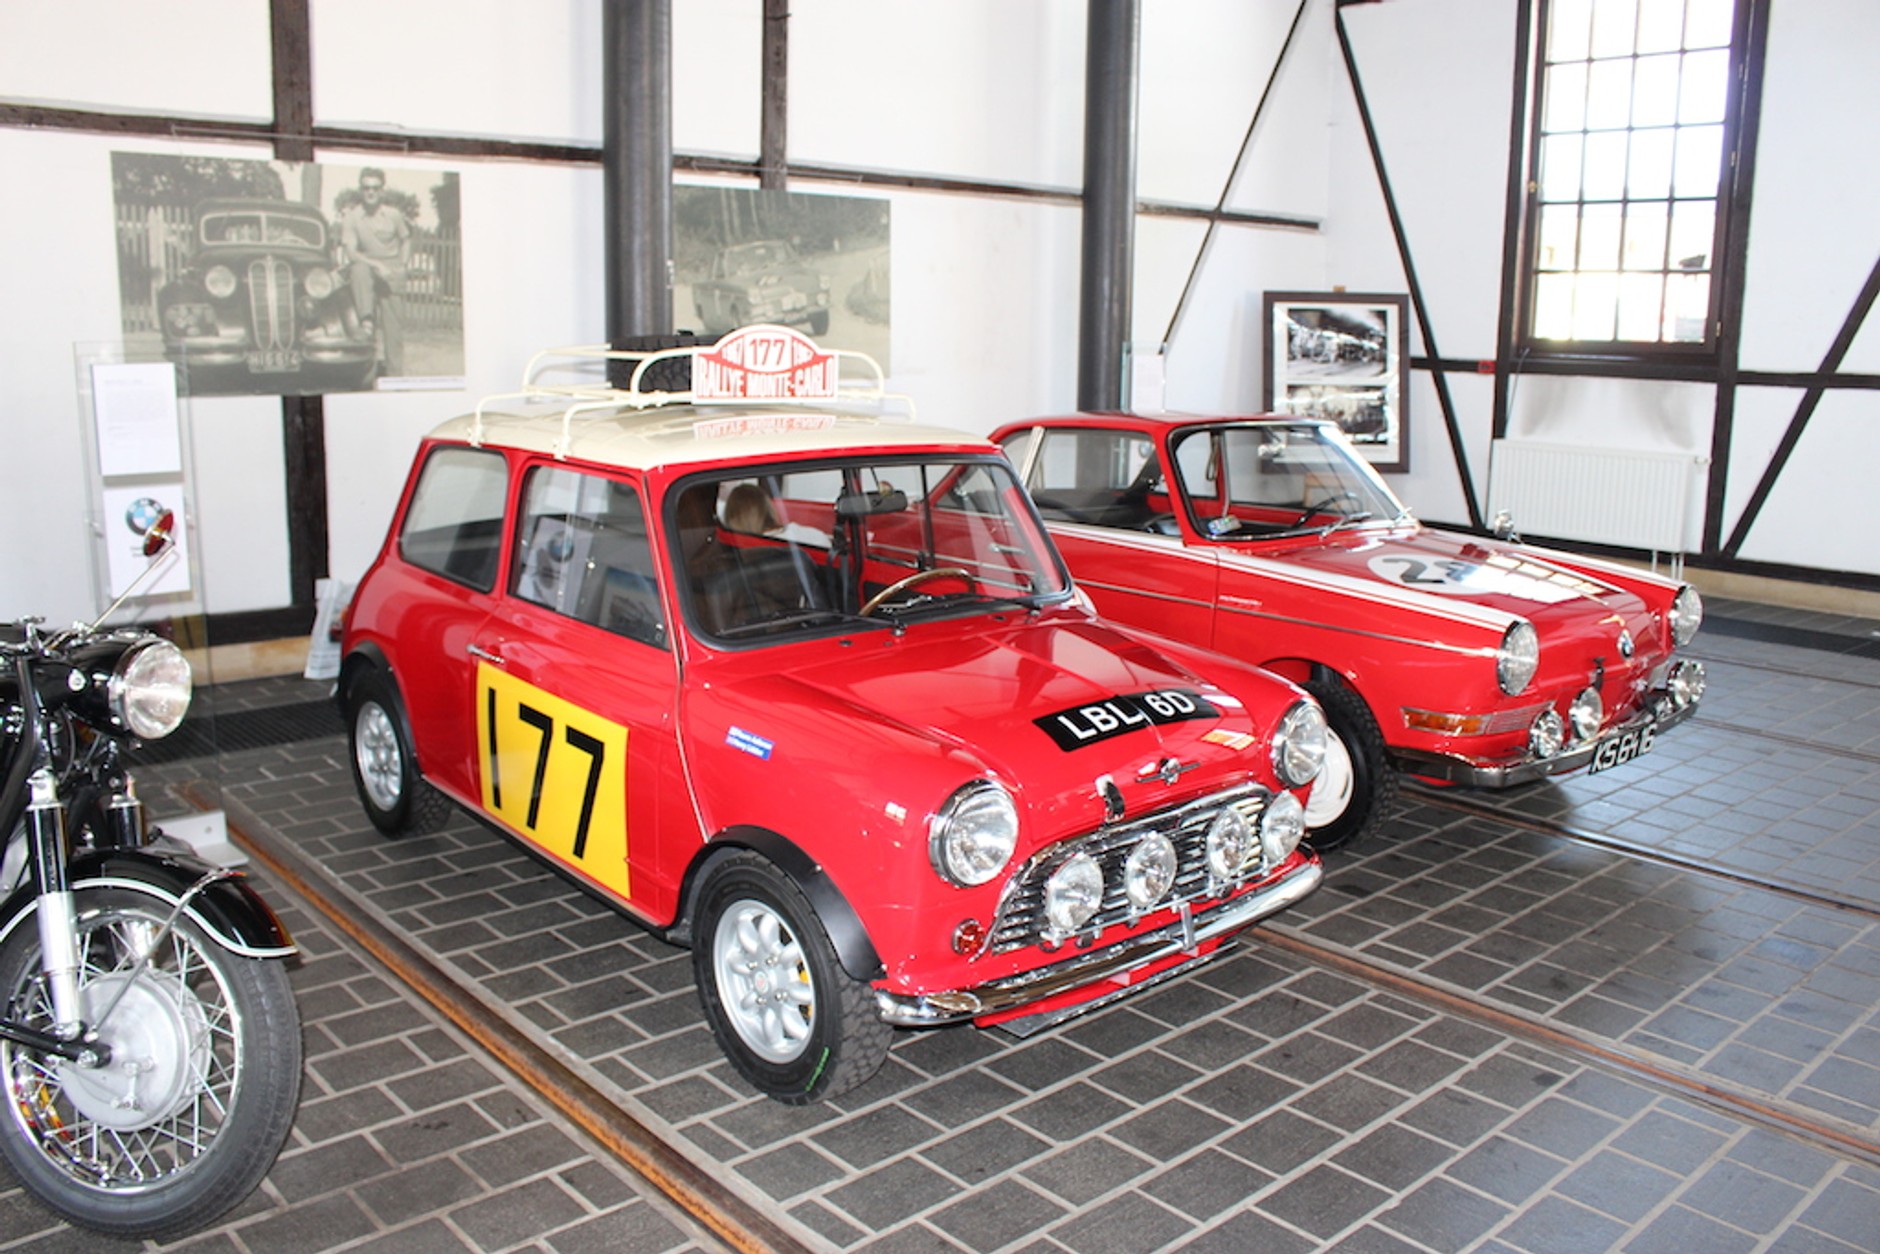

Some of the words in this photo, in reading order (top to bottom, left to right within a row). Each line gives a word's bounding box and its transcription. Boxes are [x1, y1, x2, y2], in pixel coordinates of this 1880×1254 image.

[749, 338, 786, 366] 177
[697, 356, 744, 396] RALLYE
[746, 357, 834, 396] MONTE-CARLO
[1057, 702, 1144, 740] LBL
[1144, 690, 1197, 718] 6D
[488, 687, 605, 860] 177
